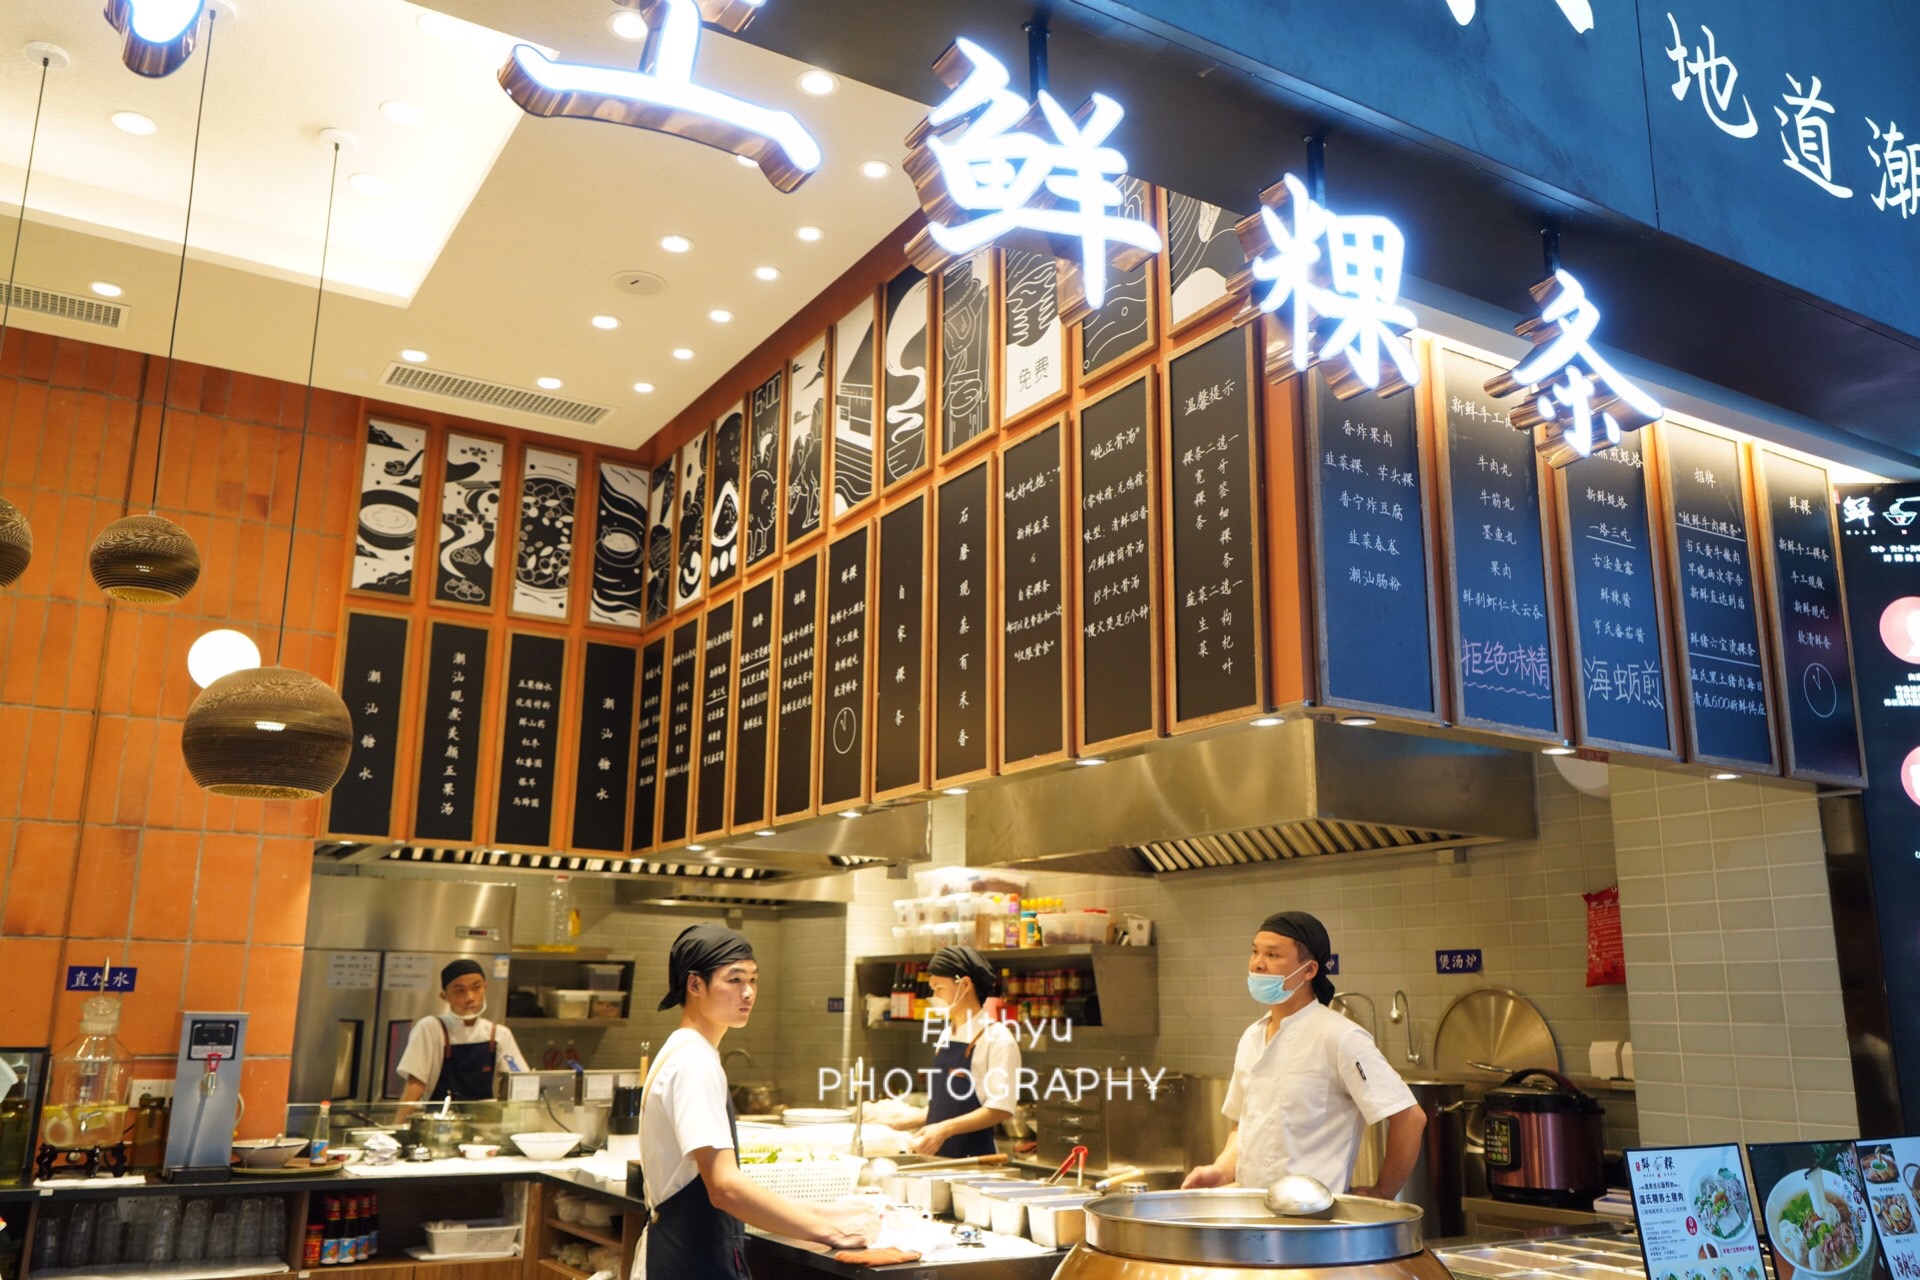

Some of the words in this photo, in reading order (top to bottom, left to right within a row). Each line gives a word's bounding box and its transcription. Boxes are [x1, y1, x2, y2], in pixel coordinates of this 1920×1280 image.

[1019, 356, 1048, 392] 免费
[1183, 379, 1235, 416] 温馨提示
[1451, 395, 1530, 435] 新鲜手工肉
[1342, 419, 1392, 447] 香炸果肉
[1477, 454, 1512, 477] 牛肉丸
[1593, 446, 1644, 469] 煎蚝烙
[1694, 467, 1716, 488] 招牌
[1339, 490, 1403, 521] 普宁炸豆腐
[1480, 488, 1515, 511] 牛筋丸
[1348, 529, 1400, 555] 韭菜春卷
[1482, 524, 1517, 545] 墨鱼丸
[1349, 566, 1401, 592] 潮汕肠粉
[1490, 561, 1512, 579] 果肉
[1198, 617, 1209, 657] 生菜
[1461, 639, 1550, 691] 拒绝味精
[1583, 656, 1664, 710] 海蛎煎
[358, 670, 382, 781] 潮汕糖水
[596, 697, 615, 801] 潮汕糖水
[1439, 954, 1477, 970] 煲汤炉
